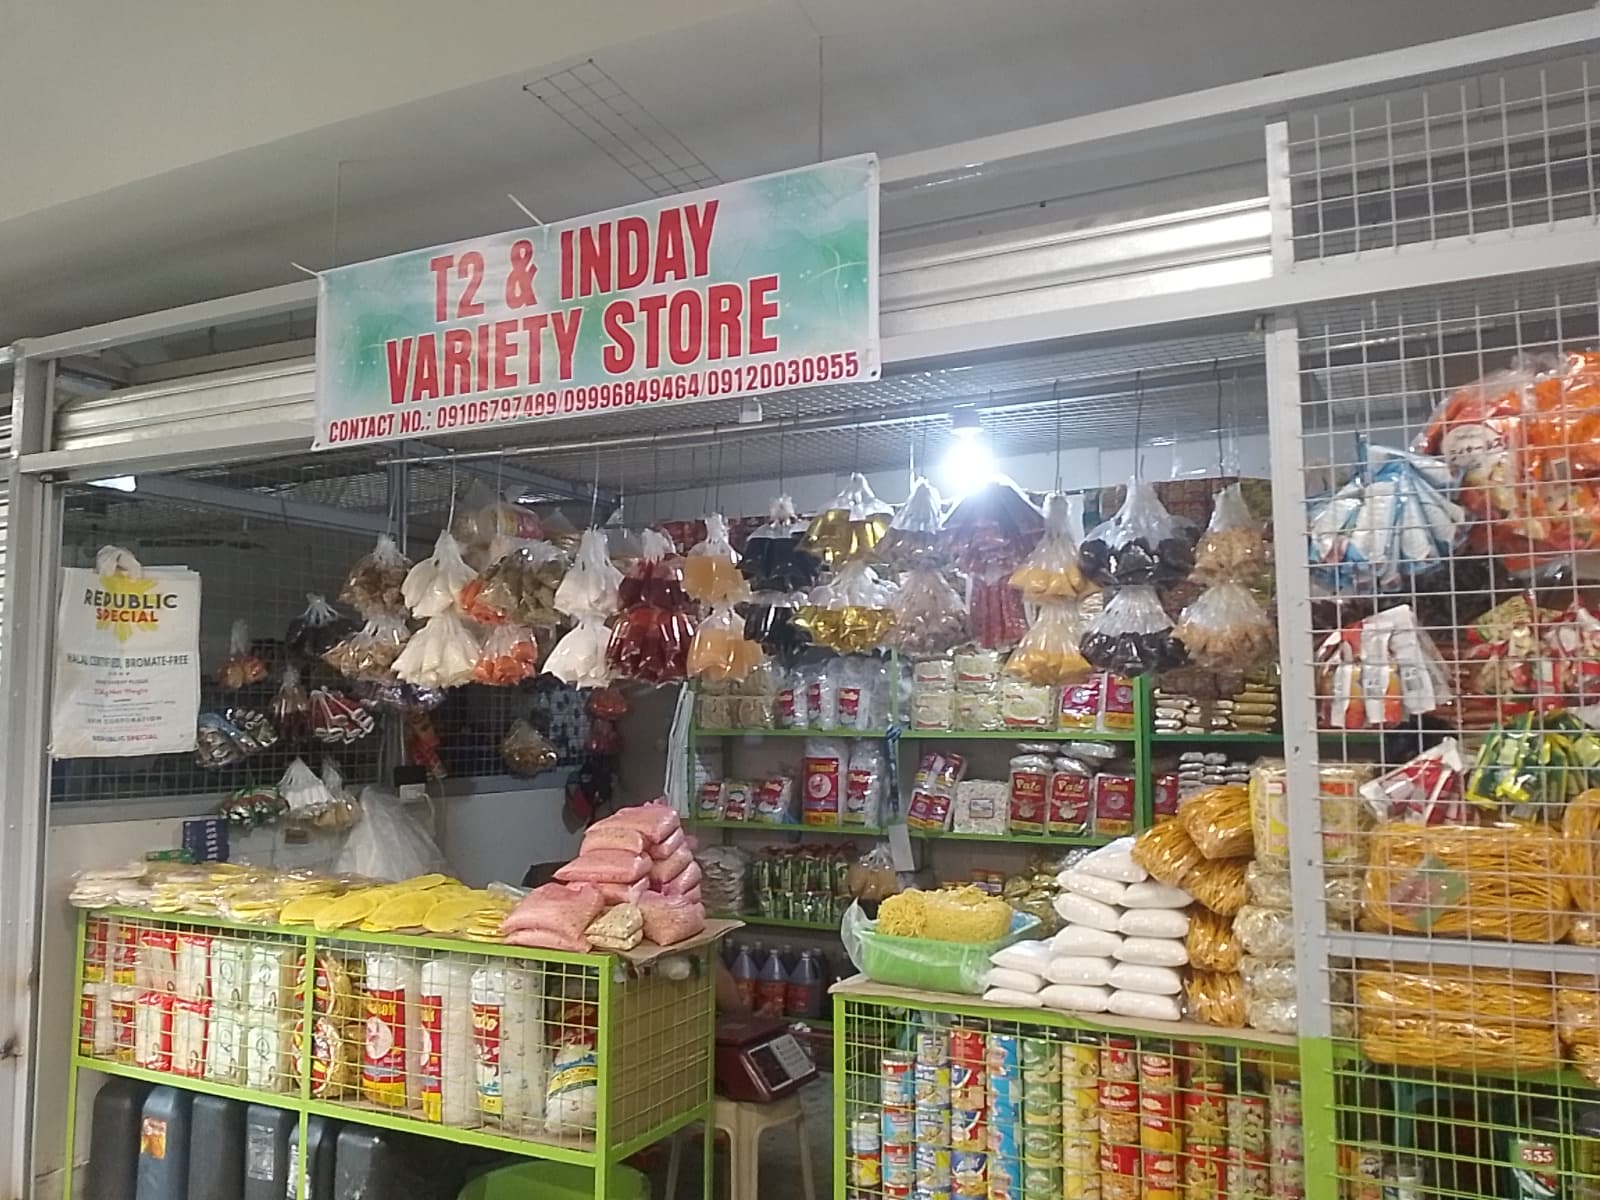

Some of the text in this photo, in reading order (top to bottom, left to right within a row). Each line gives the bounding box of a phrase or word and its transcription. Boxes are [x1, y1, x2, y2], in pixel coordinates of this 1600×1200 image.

[430, 199, 719, 322] T2 & INDAY
[386, 275, 779, 405] VARIETY STORE
[329, 413, 394, 442] CONTACT
[400, 410, 431, 433] NO.:
[84, 589, 179, 609] REPUBLIC
[96, 608, 159, 623] SPECIAL
[125, 655, 189, 668] BROMATE-FREE
[1522, 1149, 1553, 1162] 555
